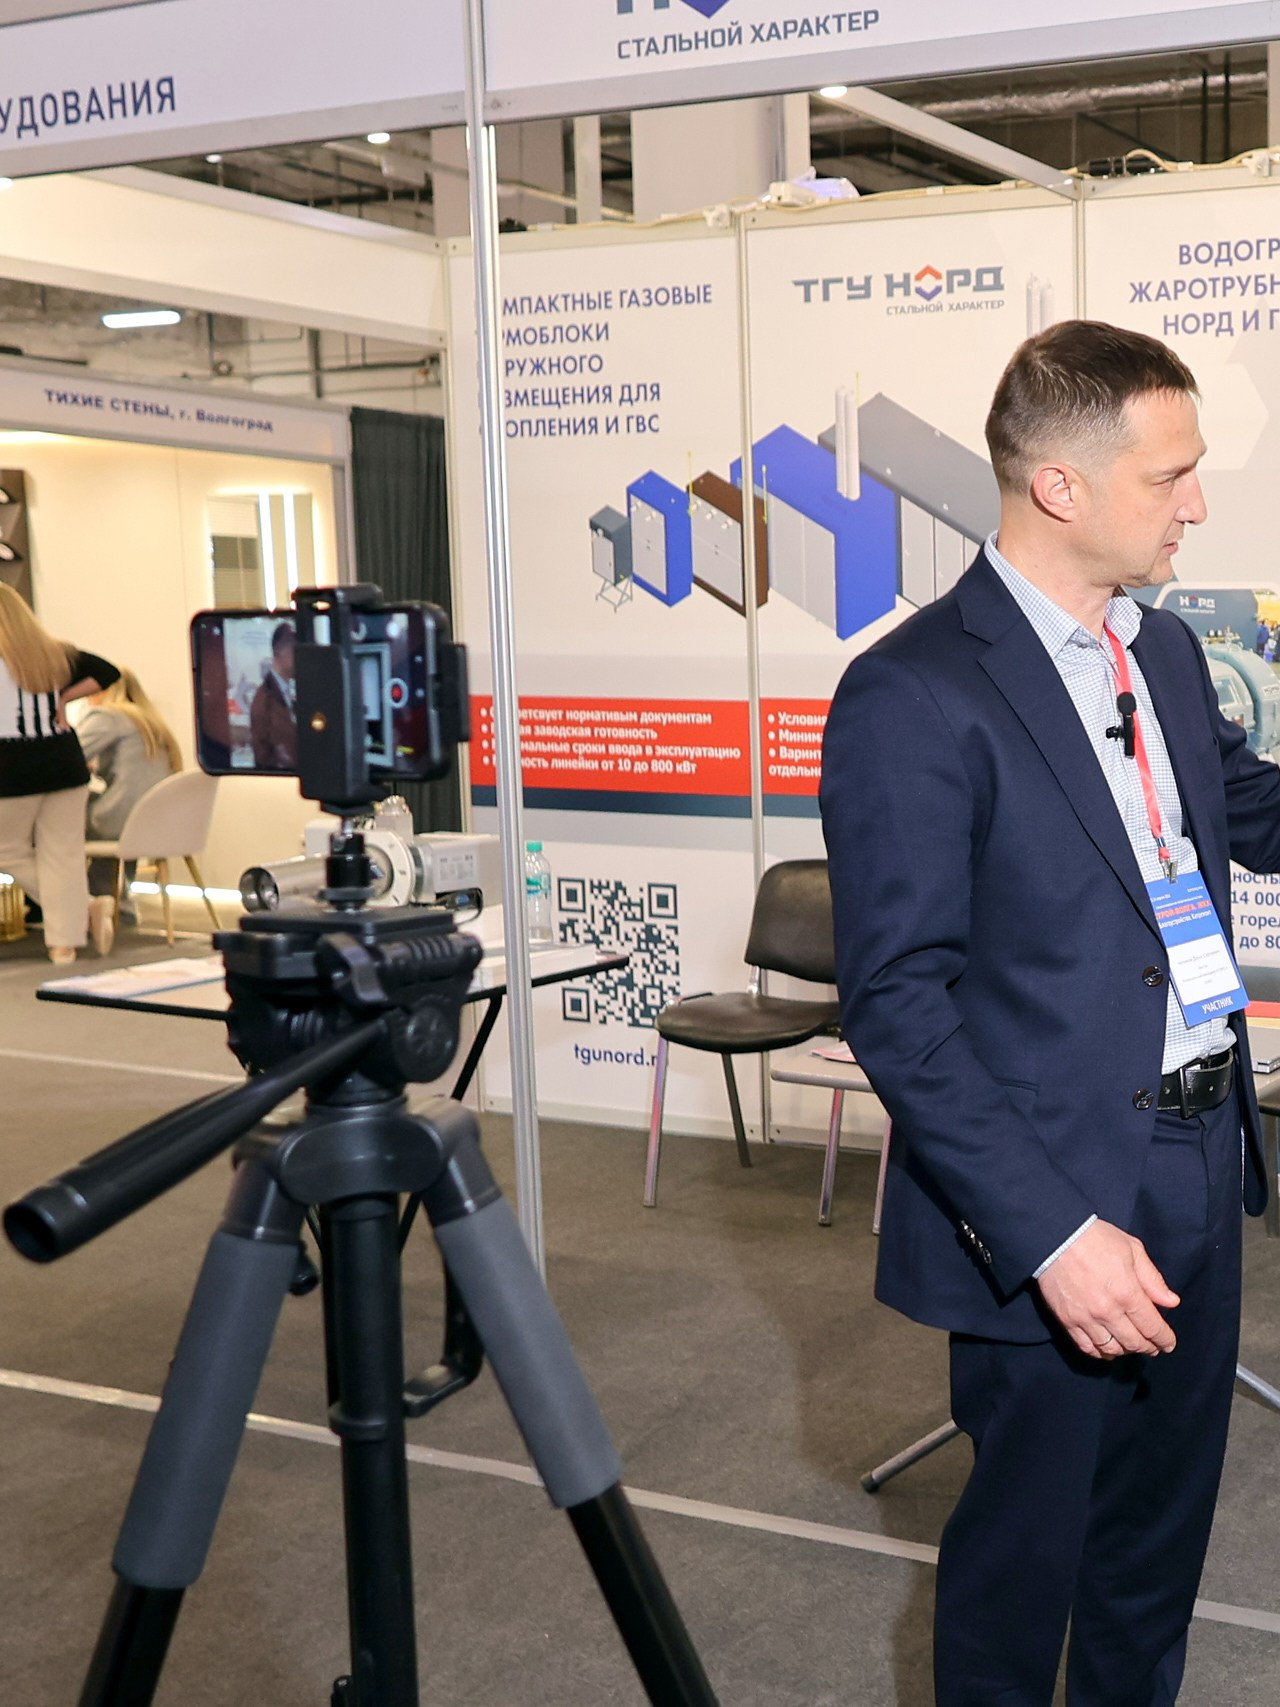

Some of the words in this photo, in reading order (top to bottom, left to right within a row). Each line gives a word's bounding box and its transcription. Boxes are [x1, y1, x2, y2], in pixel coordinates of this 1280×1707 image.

[617, 21, 742, 60] СТАЛЬНОЙ
[750, 9, 880, 44] ХАРАКТЕР
[0, 75, 175, 139] УДОВАНИЯ
[792, 275, 873, 303] ТГУ
[884, 265, 1005, 301] НОРД
[502, 290, 613, 316] МПАКТНЫЕ
[619, 284, 713, 308] ГАЗОВЫЕ
[886, 301, 943, 316] СТАЛЬНОЙ
[947, 299, 1005, 313] ХАРАКТЕР
[503, 322, 610, 347] МОБЛОКИ
[1163, 311, 1234, 337] НОРД
[1242, 309, 1260, 332] И
[505, 354, 604, 377] РУЖНОГО
[45, 389, 103, 409] ТИХИЕ
[504, 385, 613, 409] ЗМЕЩЕНИЯ
[619, 383, 661, 407] ДЛЯ
[506, 418, 599, 439] ОПЛЕНИЯ
[606, 416, 619, 434] И
[626, 414, 660, 433] ГВС
[640, 711, 712, 726] документам
[533, 724, 591, 739] заводская
[594, 726, 658, 741] готовность
[572, 742, 606, 757] сроки
[608, 743, 641, 757] ввода
[655, 745, 741, 760] эксплуатацию
[551, 755, 599, 770] линейки
[601, 760, 614, 772] от
[617, 758, 632, 772] 10
[633, 761, 649, 774] до
[651, 759, 673, 774] 800
[675, 760, 697, 774] кВт
[1231, 889, 1249, 905] 14
[1239, 936, 1260, 950] до
[574, 1043, 658, 1066] tgunord.r
